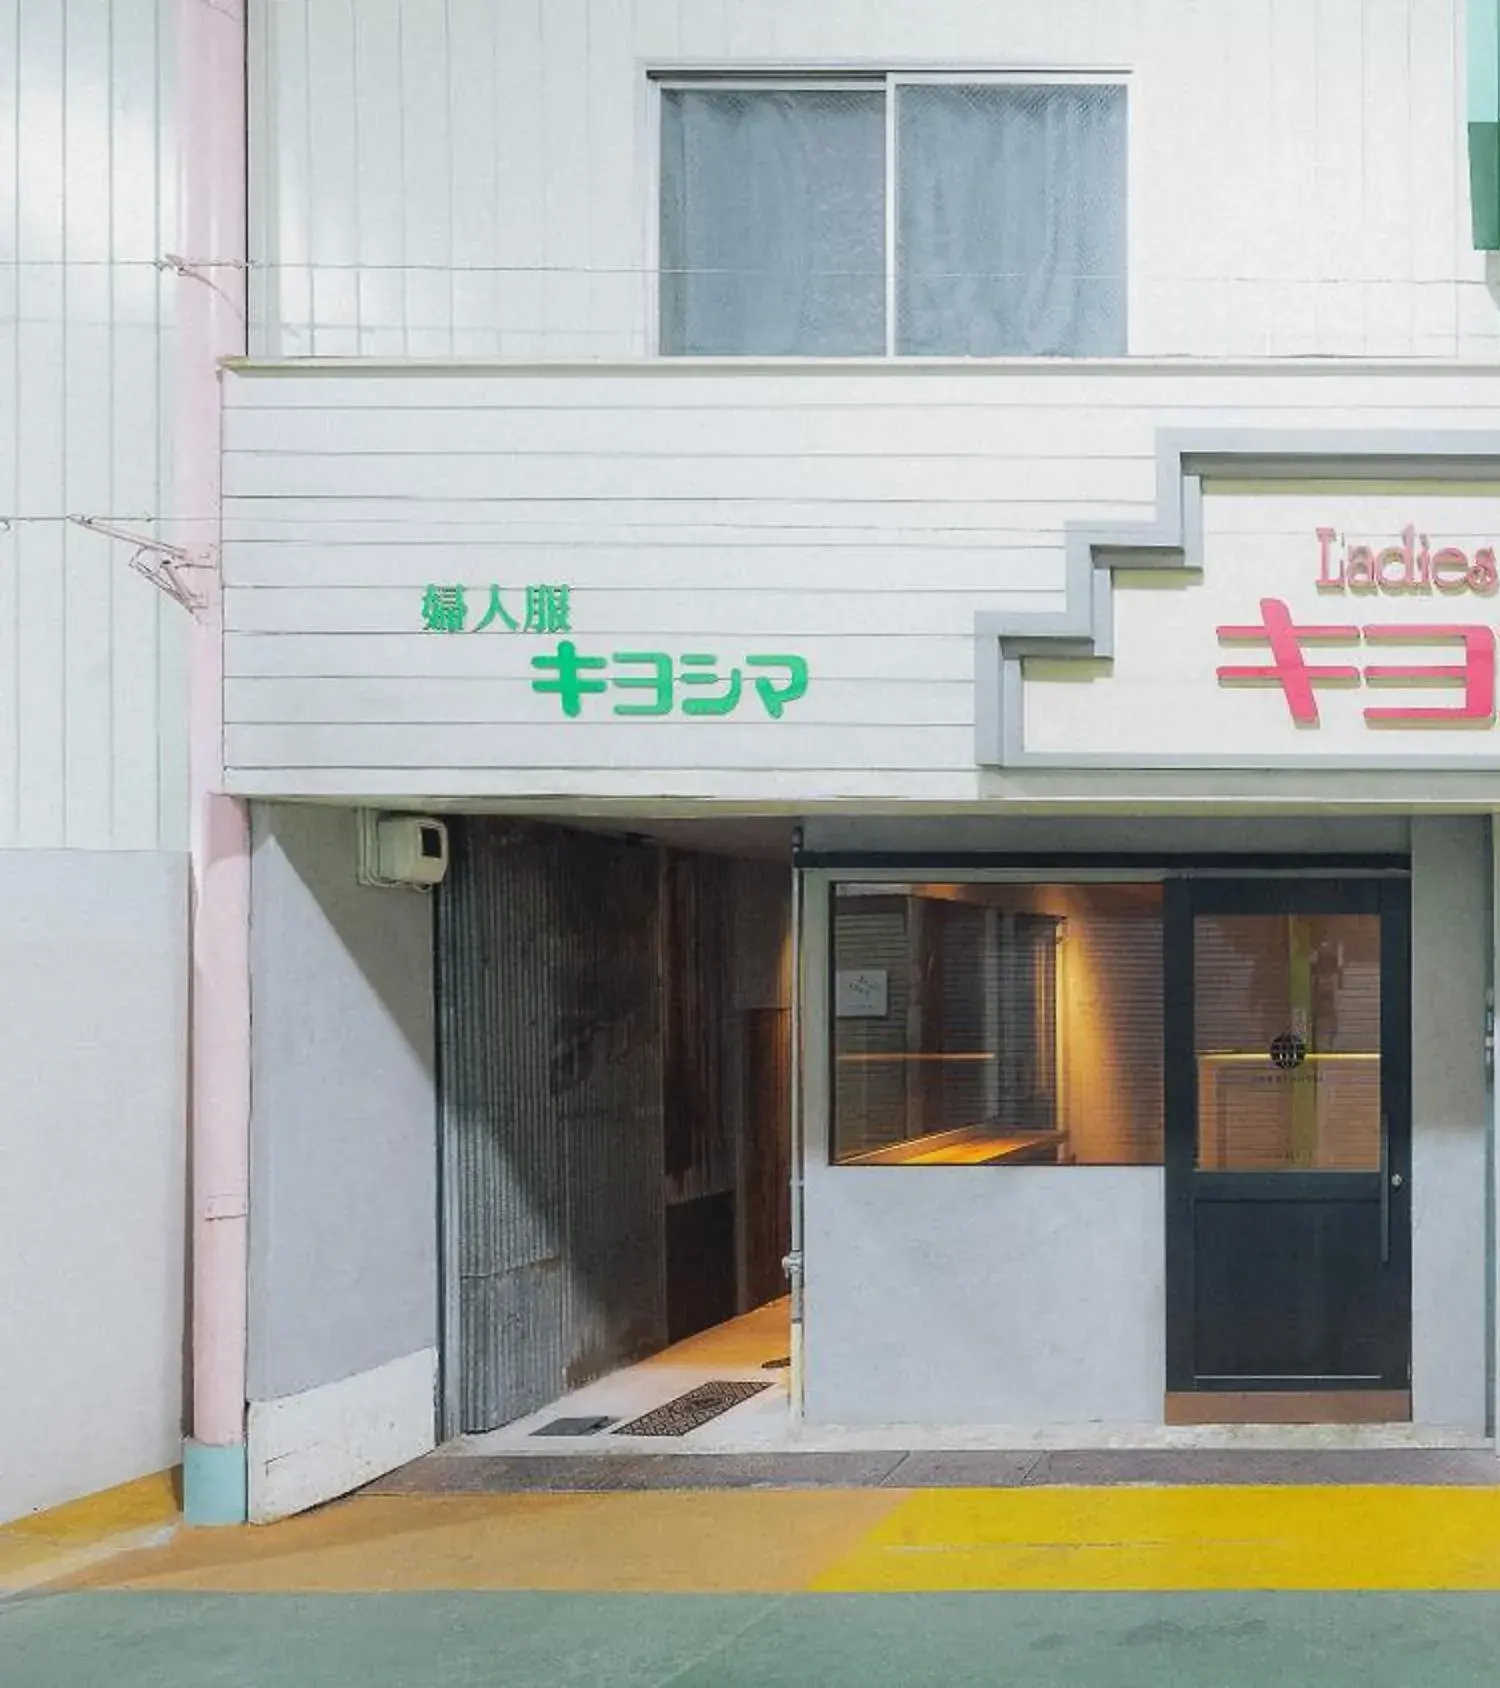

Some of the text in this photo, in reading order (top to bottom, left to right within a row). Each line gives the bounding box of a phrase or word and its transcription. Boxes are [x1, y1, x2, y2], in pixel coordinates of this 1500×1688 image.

[1316, 525, 1499, 593] Ladies
[421, 584, 573, 634] 婦人服
[531, 640, 810, 719] キヨシマ
